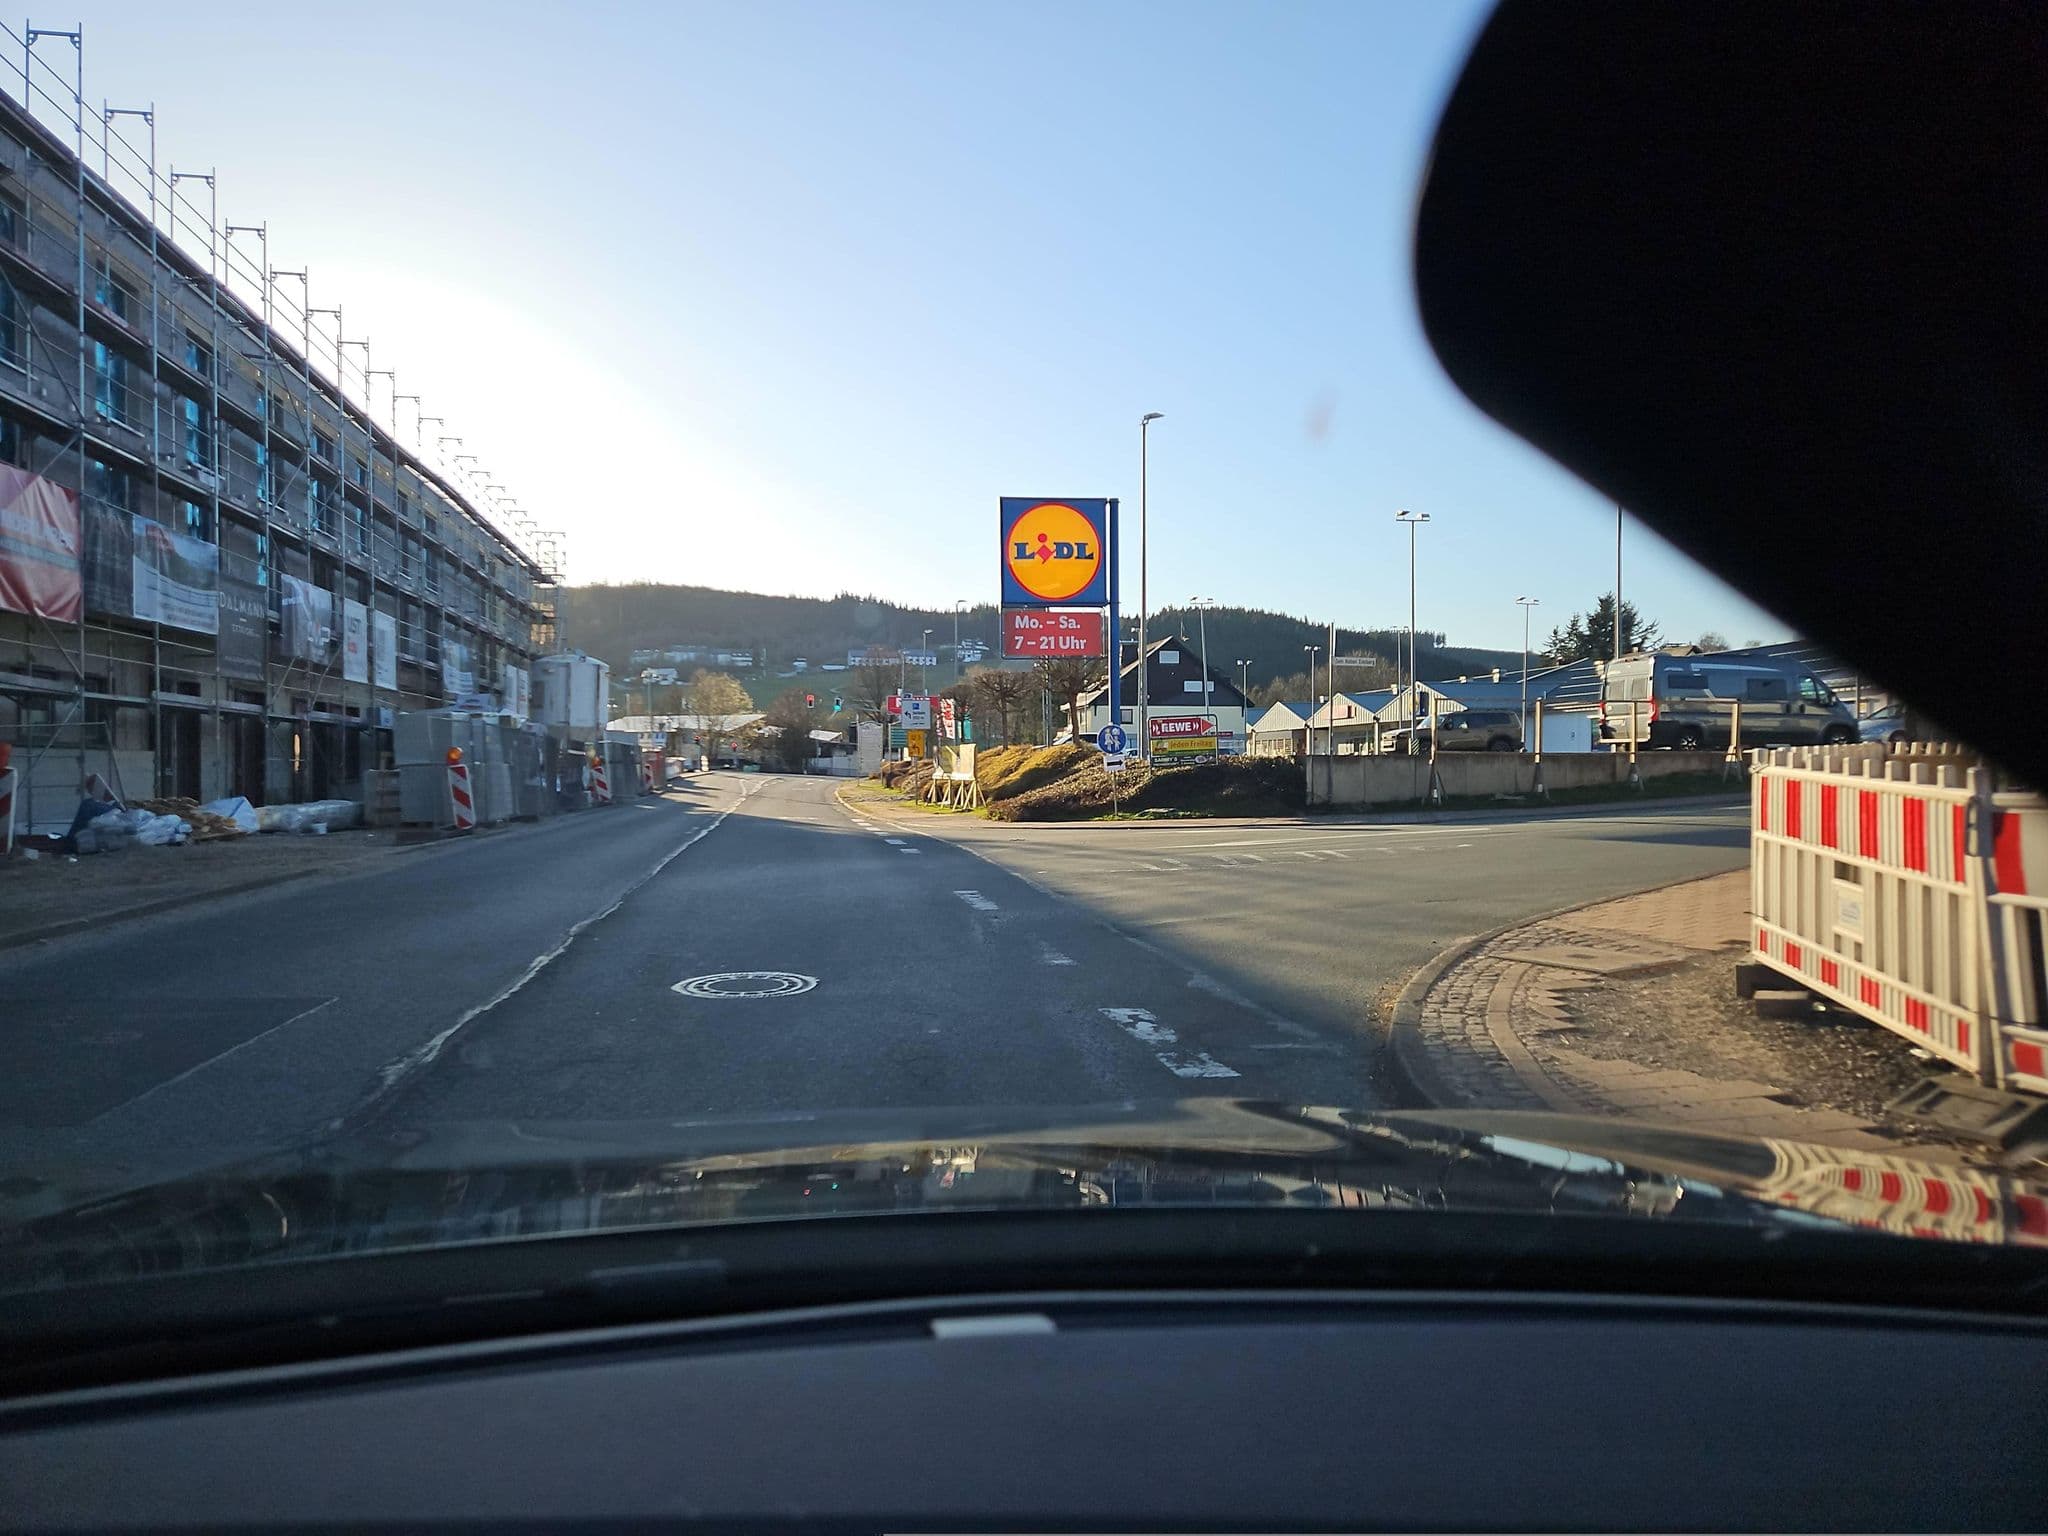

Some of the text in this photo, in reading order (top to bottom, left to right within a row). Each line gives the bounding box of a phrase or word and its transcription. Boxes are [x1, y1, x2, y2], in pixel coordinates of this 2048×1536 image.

[1015, 615, 1043, 629] Mo.
[1059, 615, 1080, 629] Sa.
[1015, 636, 1024, 650] 7
[1040, 636, 1055, 650] 21
[1059, 636, 1087, 650] Uhr
[1161, 721, 1192, 733] REWE
